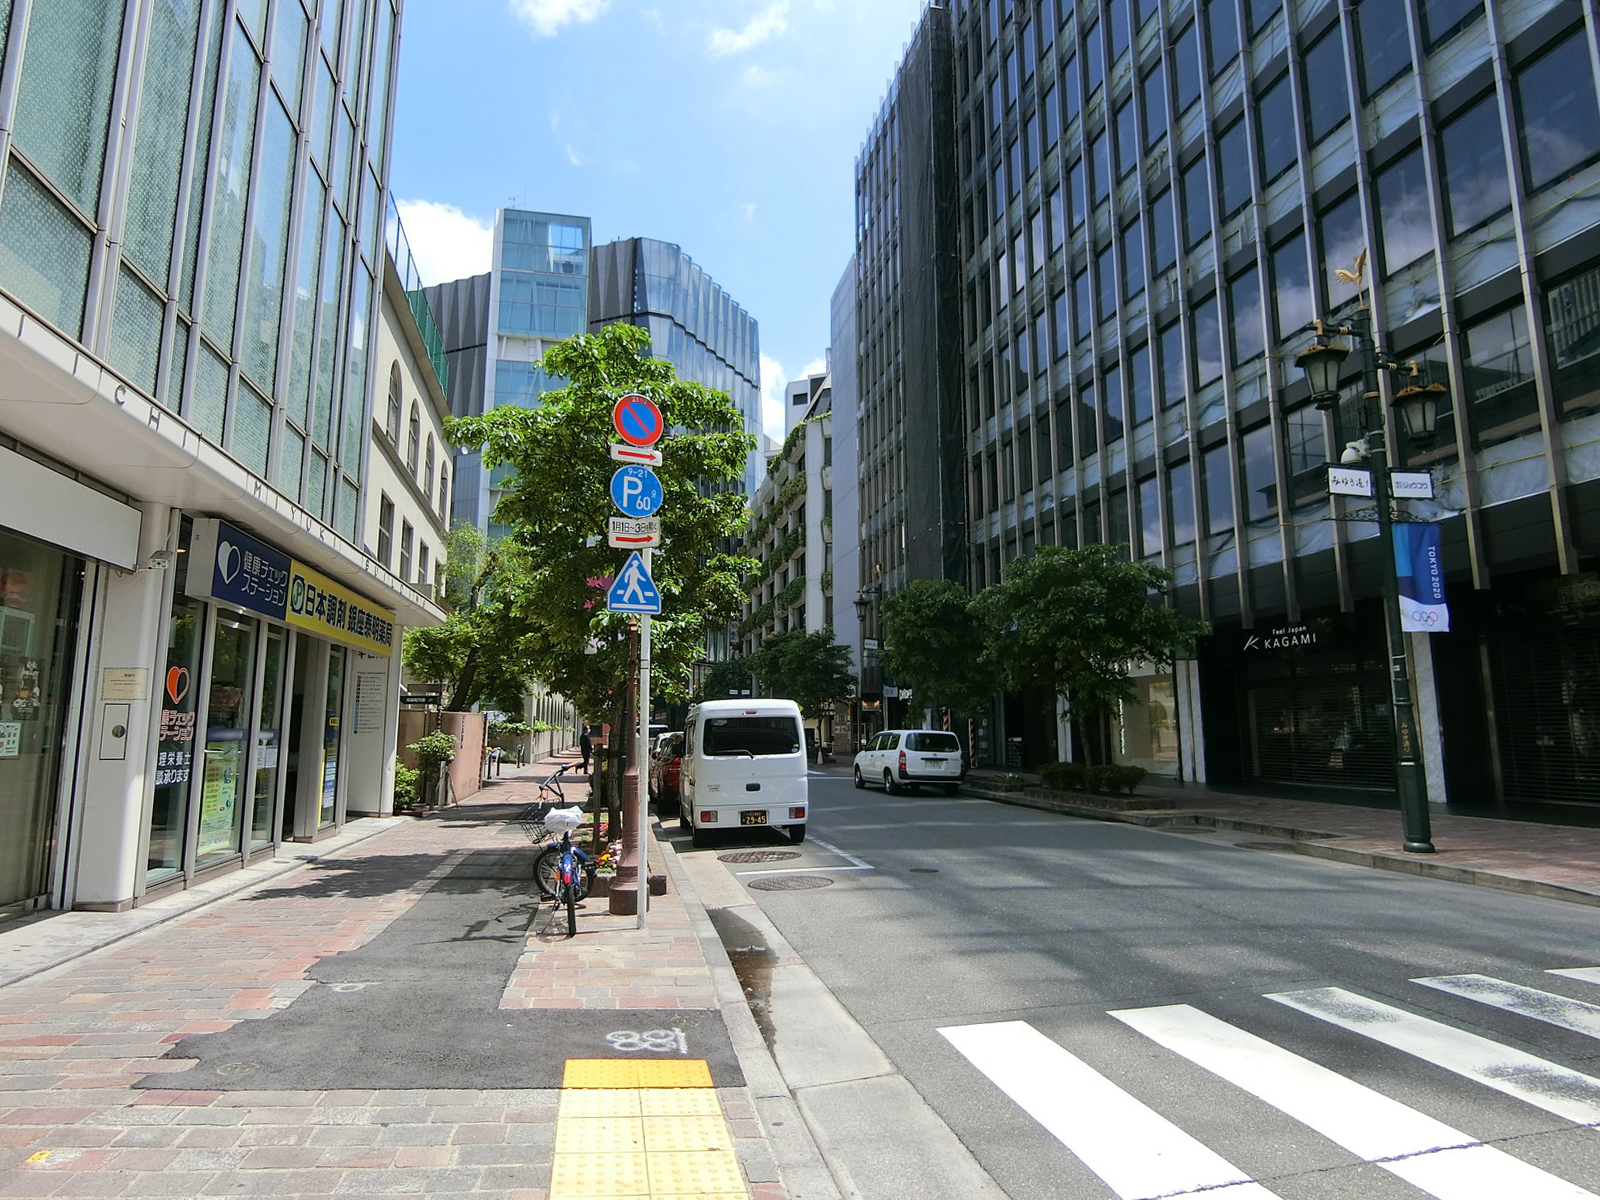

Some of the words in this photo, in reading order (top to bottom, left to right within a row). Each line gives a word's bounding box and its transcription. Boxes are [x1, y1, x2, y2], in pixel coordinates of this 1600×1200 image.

[628, 467, 648, 478] 9-21
[622, 475, 643, 508] P
[253, 480, 337, 548] MIYUKI
[243, 550, 288, 588] 健康チェック
[1427, 545, 1439, 576] TOKYO
[241, 573, 286, 607] ステーション
[1431, 576, 1442, 599] 2020
[305, 584, 348, 630] 日本調剤
[1264, 633, 1316, 649] KAGAMI
[746, 815, 766, 825] 29-45
